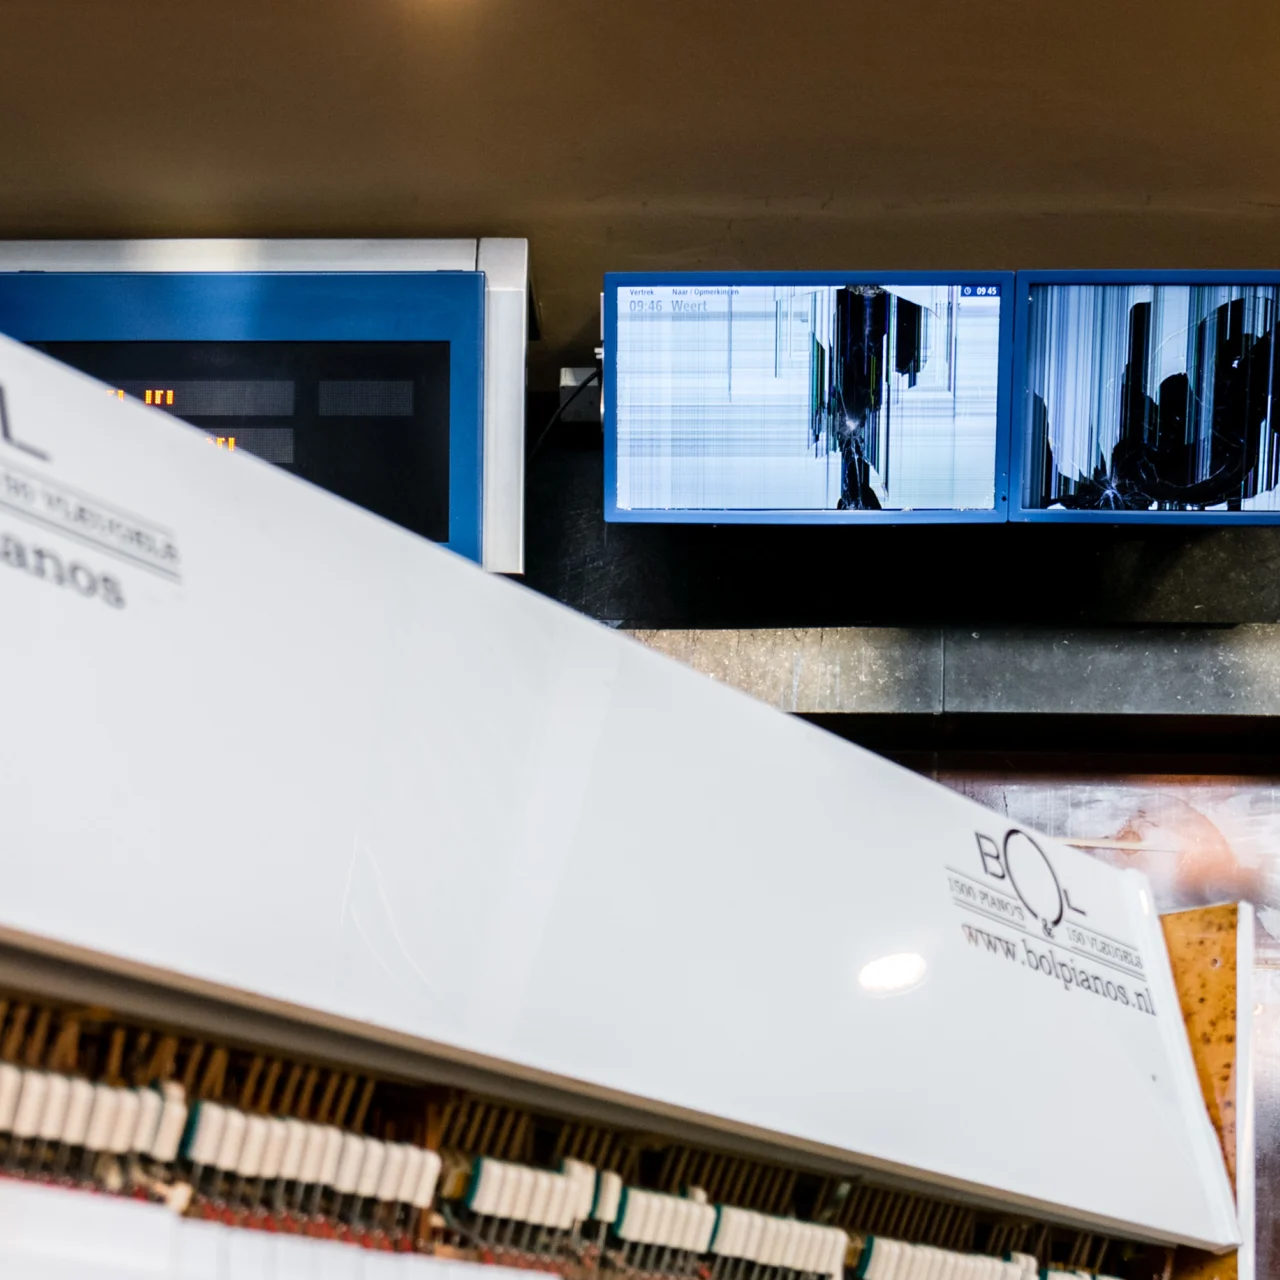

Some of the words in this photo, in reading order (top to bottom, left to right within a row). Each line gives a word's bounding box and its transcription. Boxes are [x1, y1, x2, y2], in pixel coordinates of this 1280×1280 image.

[629, 288, 654, 296] Vertrek
[672, 288, 688, 296] Naar
[629, 299, 663, 312] 09:46
[671, 299, 708, 312] Weert
[961, 924, 1158, 1017] www.bolpianos.nl
